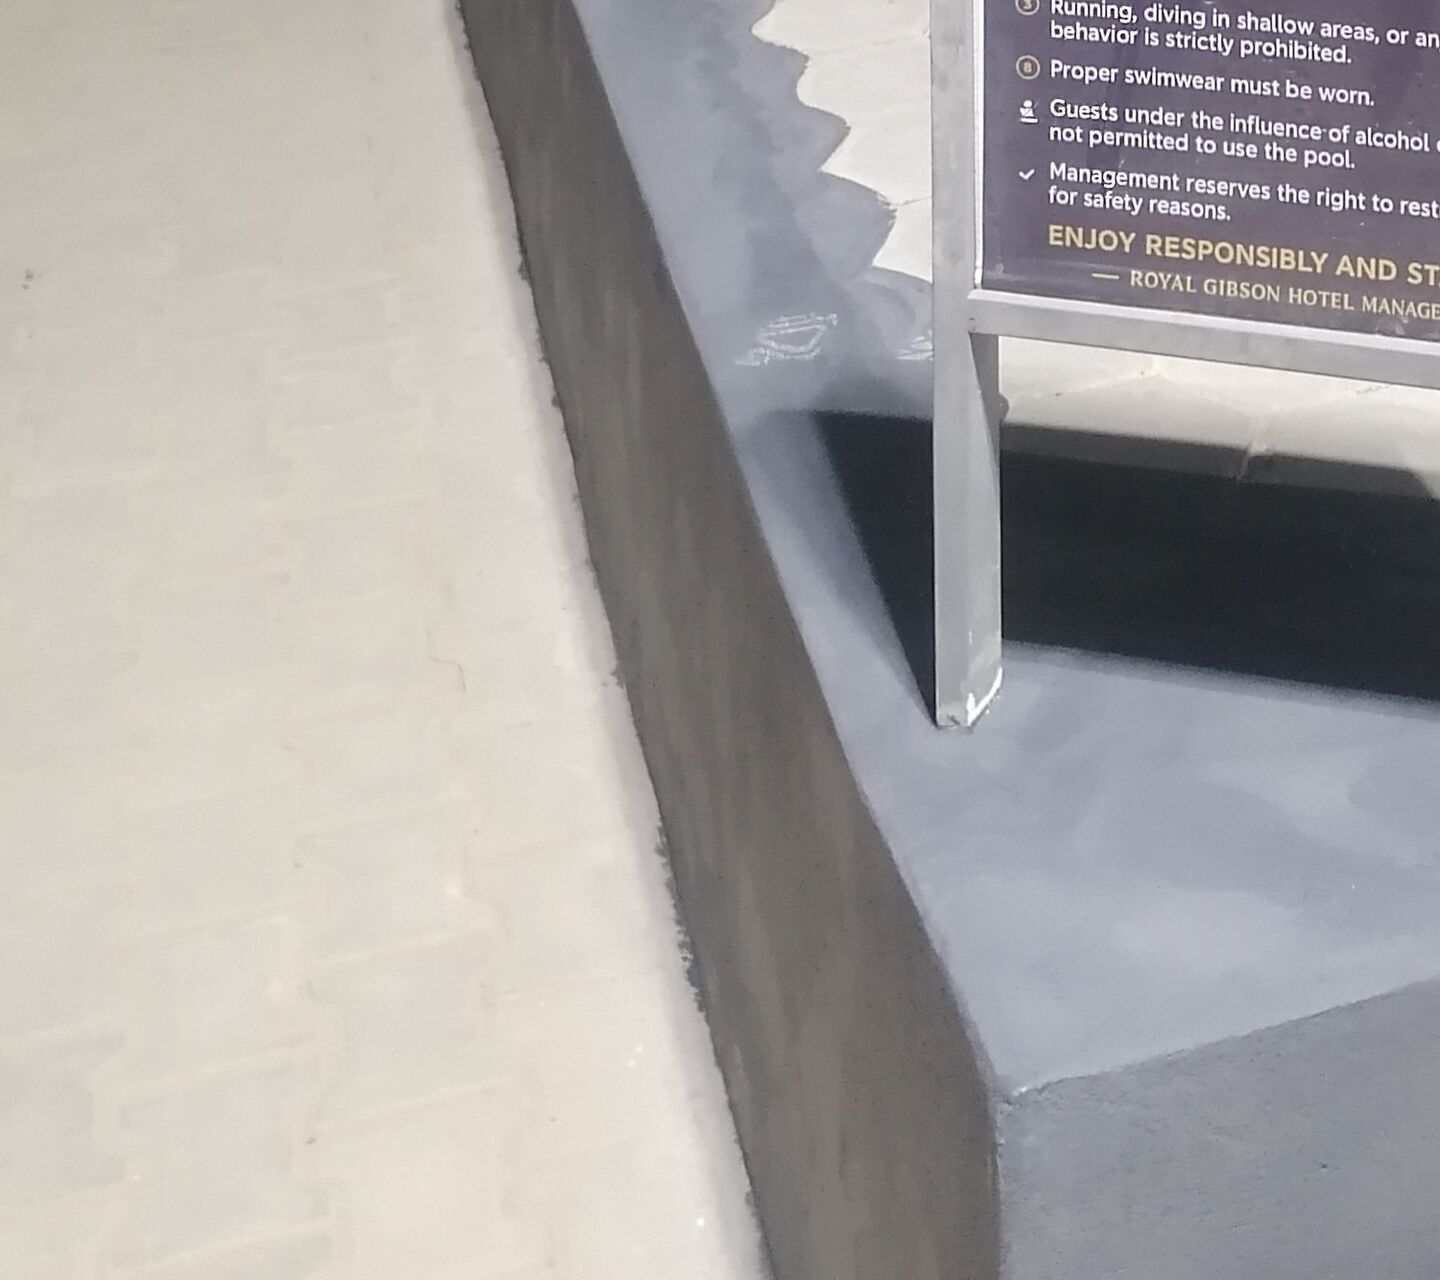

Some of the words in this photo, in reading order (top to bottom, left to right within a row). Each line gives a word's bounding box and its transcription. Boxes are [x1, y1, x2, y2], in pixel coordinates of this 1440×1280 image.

[1050, 18, 1139, 45] behavior
[1144, 26, 1160, 47] is
[1164, 30, 1235, 57] strictly
[1239, 37, 1352, 65] prohibited.
[1143, 2, 1207, 31] diving
[1212, 7, 1230, 30] in
[1236, 10, 1315, 36] shallow
[1319, 21, 1380, 46] areas,
[1385, 28, 1410, 46] or
[1050, 58, 1120, 85] Proper
[1124, 65, 1226, 92] swimwear
[1230, 77, 1281, 97] must
[1285, 78, 1313, 100] be
[1317, 86, 1375, 107] worn.
[1049, 97, 1119, 122] Guests
[1124, 106, 1185, 128] under
[1190, 109, 1224, 131] the
[1229, 112, 1323, 141] influence
[1327, 123, 1351, 145] of
[1354, 126, 1431, 153] alcohol
[1049, 125, 1084, 144] not
[1089, 128, 1189, 152] permitted
[1194, 134, 1217, 155] to
[1222, 140, 1259, 159] use
[1264, 141, 1298, 163] the
[1303, 148, 1356, 170] pool.
[1048, 184, 1079, 206] for
[1083, 189, 1144, 217] safety
[1149, 198, 1232, 221] reasons.
[1049, 160, 1181, 192] Management
[1185, 177, 1271, 201] reserves
[1276, 182, 1311, 205] the
[1316, 186, 1367, 212] right
[1371, 193, 1394, 213] to
[1048, 223, 1137, 253] ENJOY
[1145, 233, 1329, 274] RESPONSIBLY
[1334, 254, 1397, 281] AND
[1130, 268, 1197, 294] ROYAL
[1203, 277, 1281, 303] GIBSON
[1288, 287, 1355, 311] HOTEL
